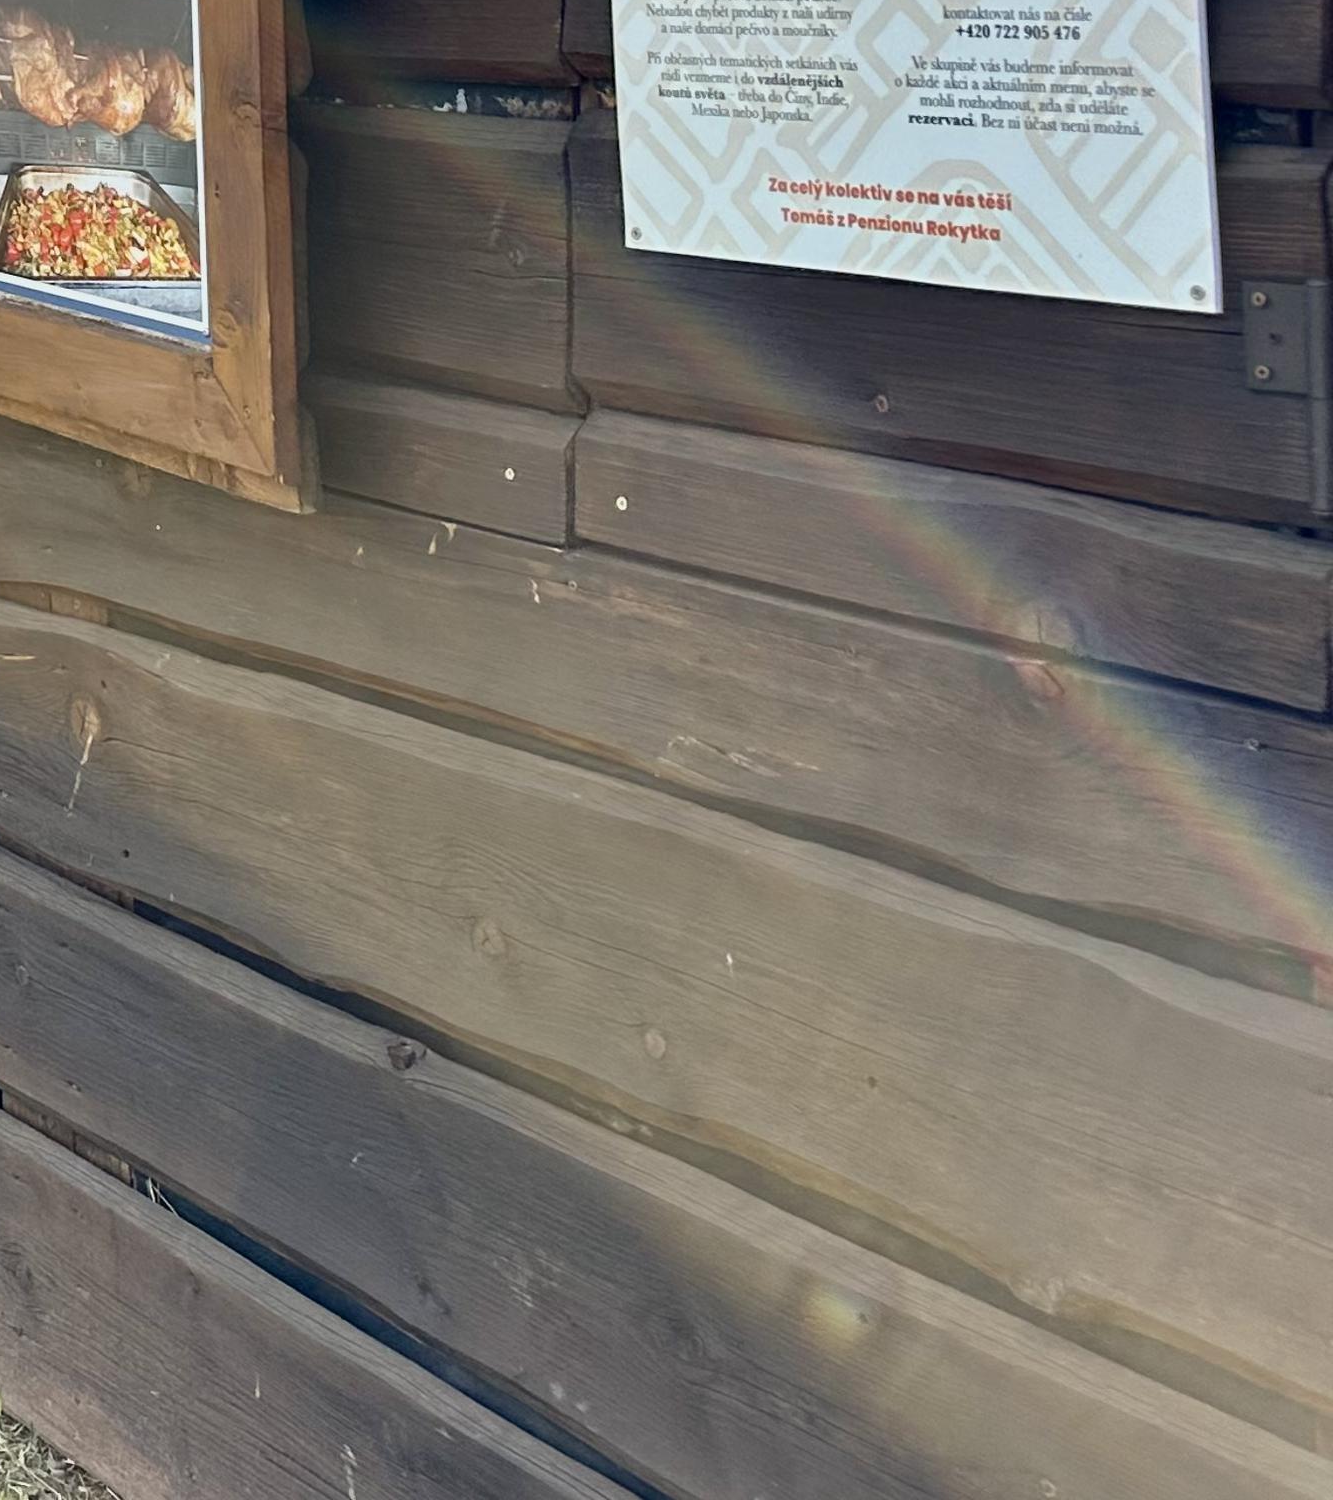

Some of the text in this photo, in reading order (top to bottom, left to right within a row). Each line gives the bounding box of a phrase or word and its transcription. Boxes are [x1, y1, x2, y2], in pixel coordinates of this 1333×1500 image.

[941, 3, 1016, 21] kontaktovat
[1016, 5, 1041, 21] nás
[1042, 9, 1061, 22] na
[954, 22, 1081, 41] +420 722 905 476
[1001, 56, 1056, 75] budeme
[767, 176, 1012, 212] Za celý kolektiv se na vás těší
[779, 206, 1001, 244] Tomáš z Penzionu Rokytka
